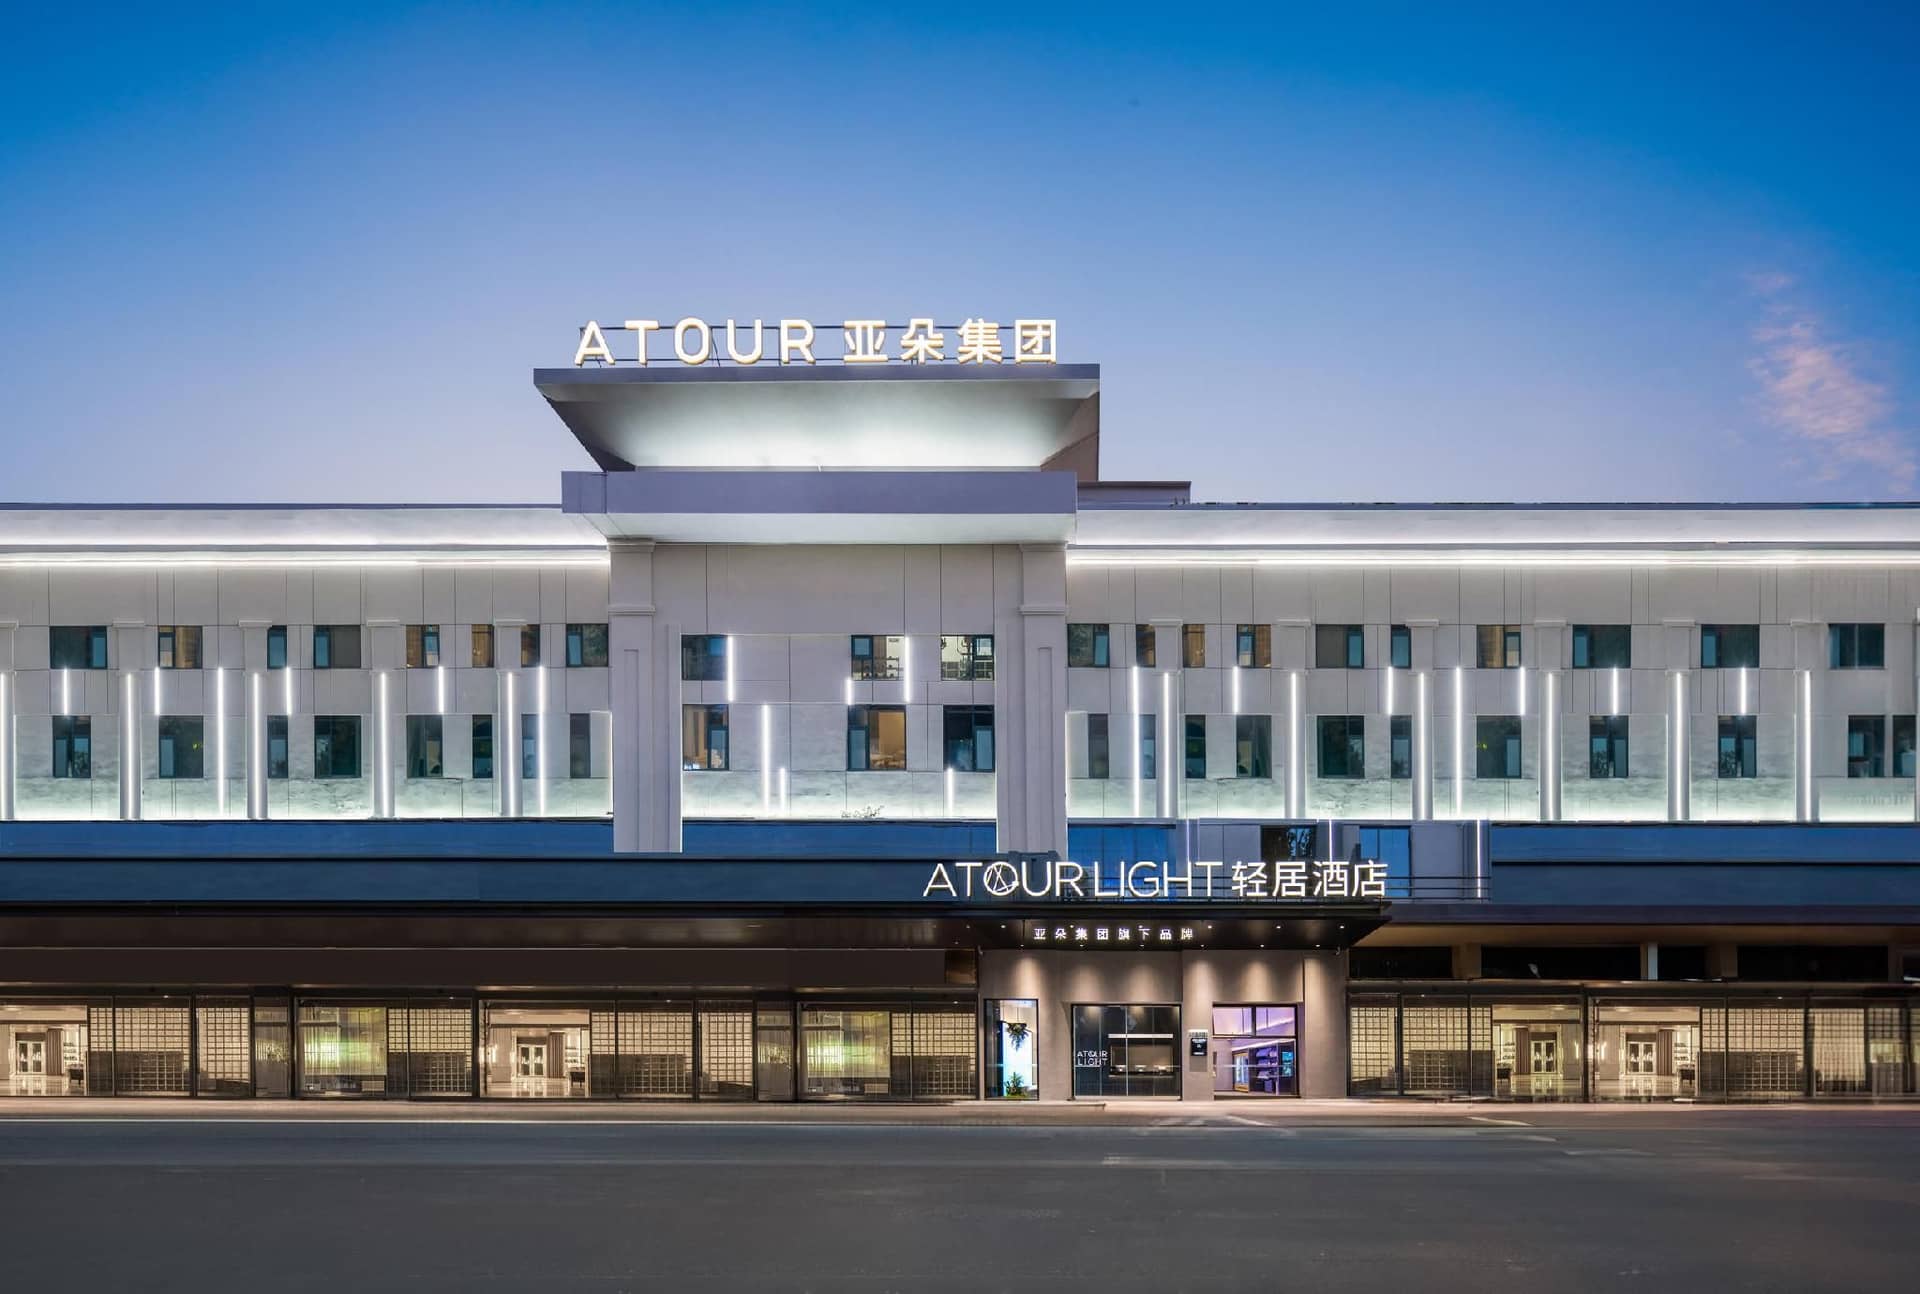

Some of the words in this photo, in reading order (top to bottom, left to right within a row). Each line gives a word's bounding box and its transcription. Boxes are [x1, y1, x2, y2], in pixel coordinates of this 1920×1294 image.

[575, 317, 816, 366] ATOUR
[843, 318, 1057, 365] 亚朵集团
[922, 861, 1084, 897] ATOUR
[1094, 861, 1223, 897] LIGHT
[1231, 860, 1388, 897] 轻居酒店
[1033, 927, 1194, 941] 亚朵集团旗下品牌
